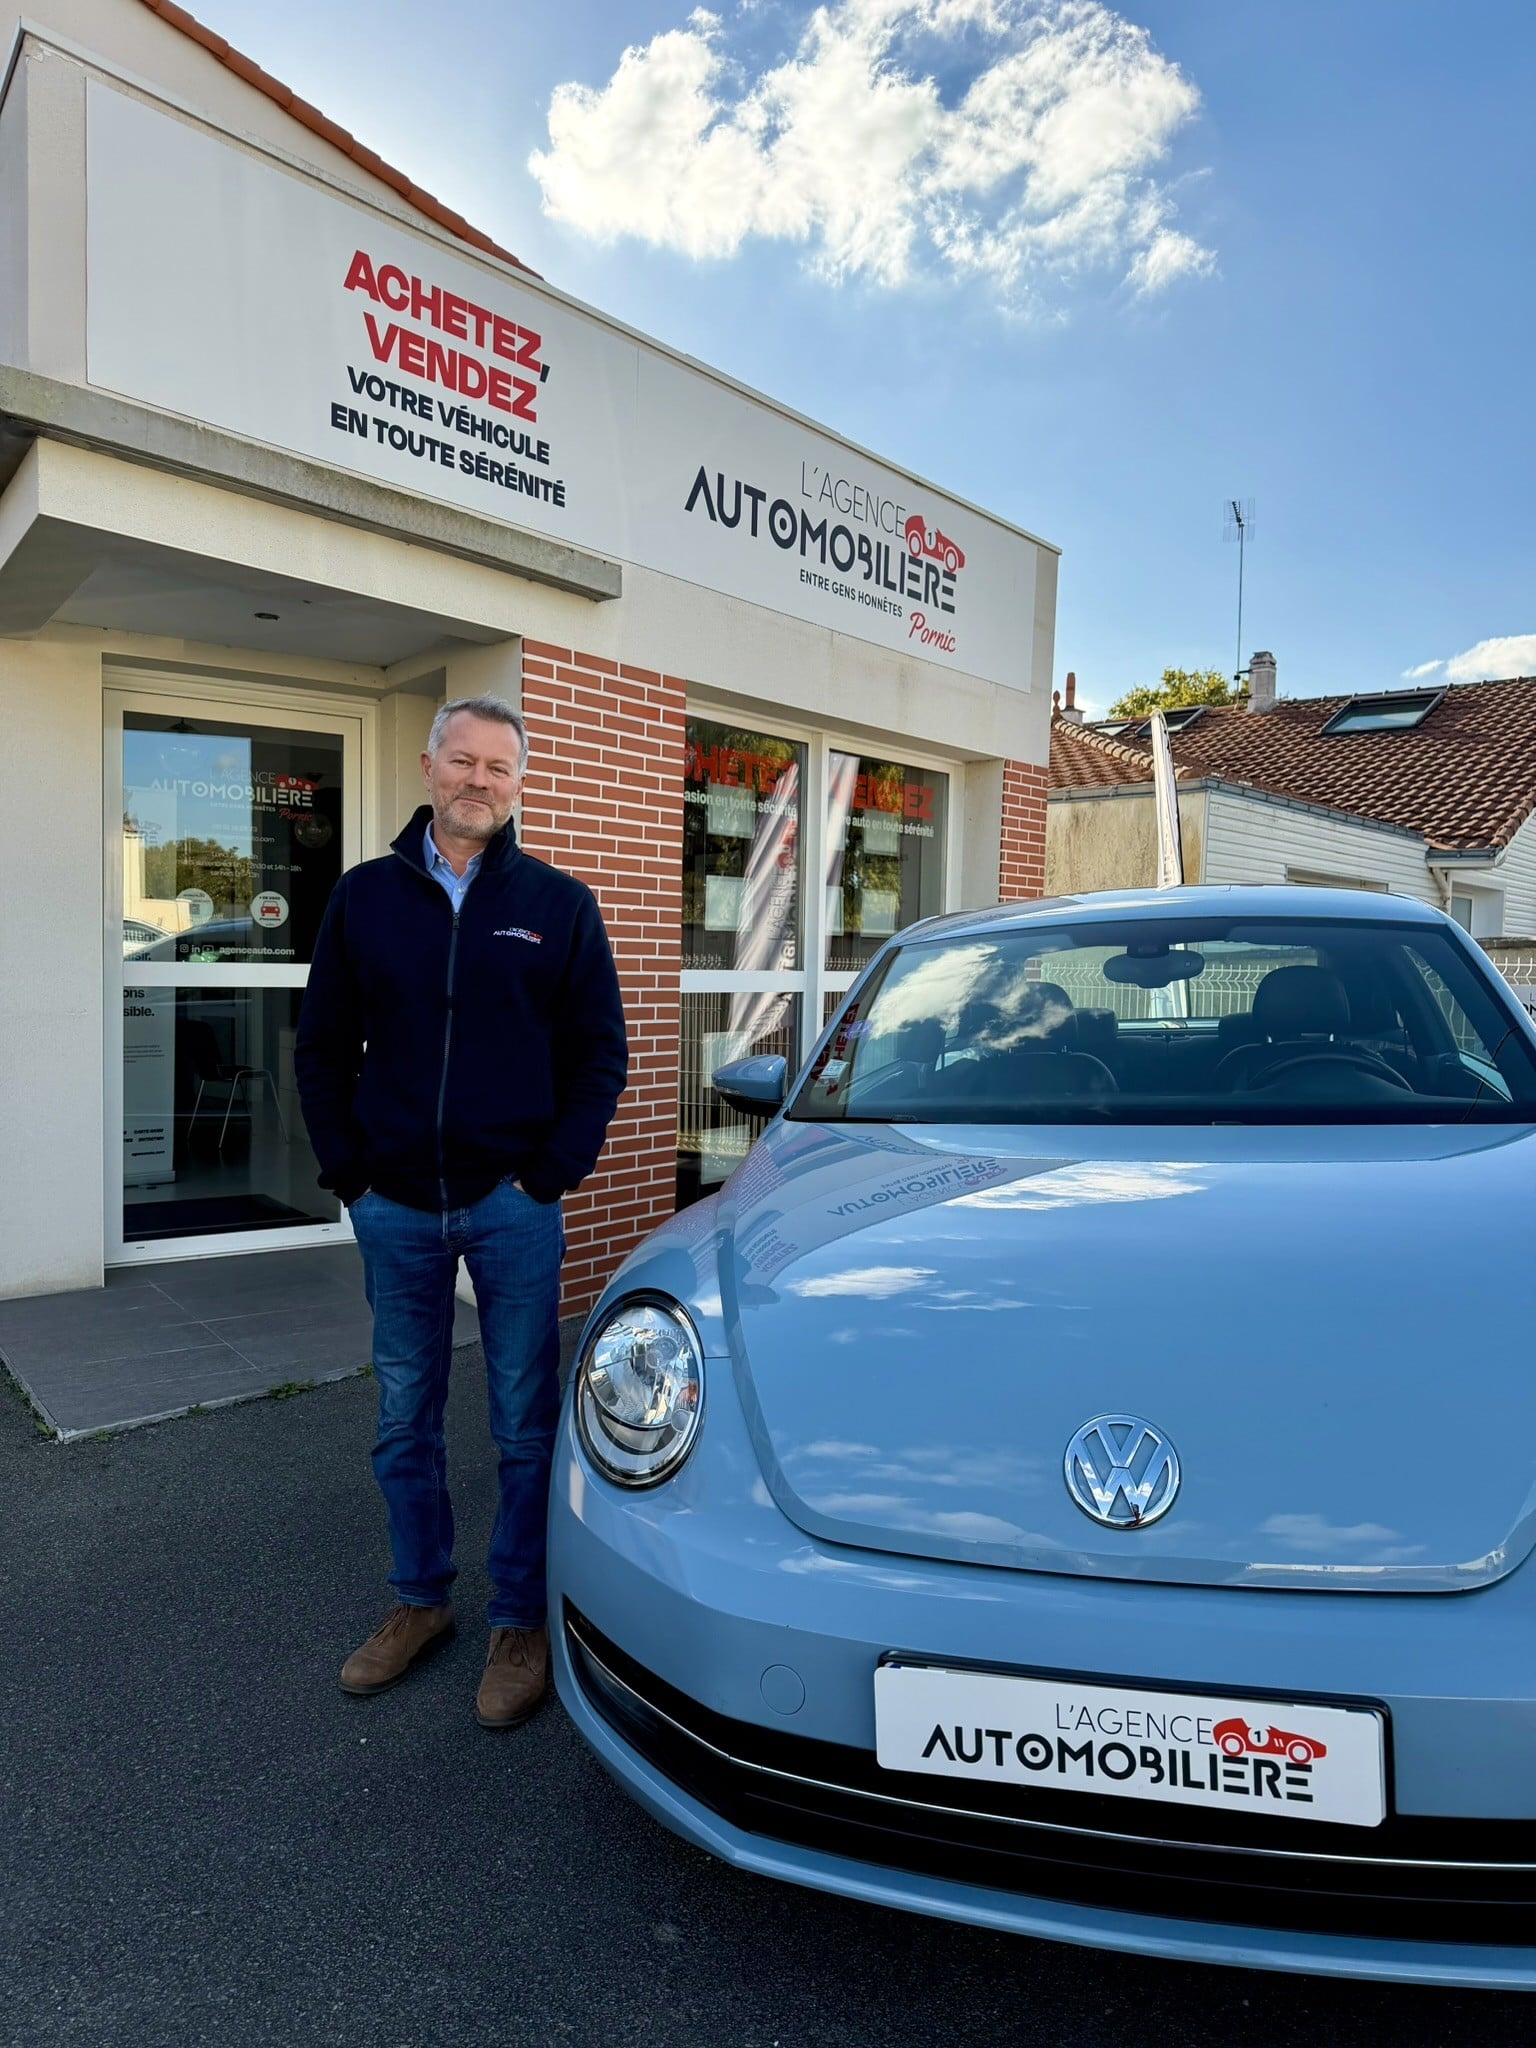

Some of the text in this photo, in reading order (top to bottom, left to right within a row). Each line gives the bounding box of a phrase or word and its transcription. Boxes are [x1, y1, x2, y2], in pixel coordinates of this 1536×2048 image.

[363, 311, 537, 423] VENDEZ
[346, 365, 550, 465] VOTRE VÉHICULE
[331, 402, 566, 508] EN TOUTE SÉRÉNITÉ
[801, 461, 907, 539] L'AGENCE
[799, 569, 903, 618] ENTRE GENS HONNÊTES
[908, 612, 957, 653] Pornic
[852, 816, 871, 829] auto
[1056, 1703, 1214, 1746] L'AGENCE
